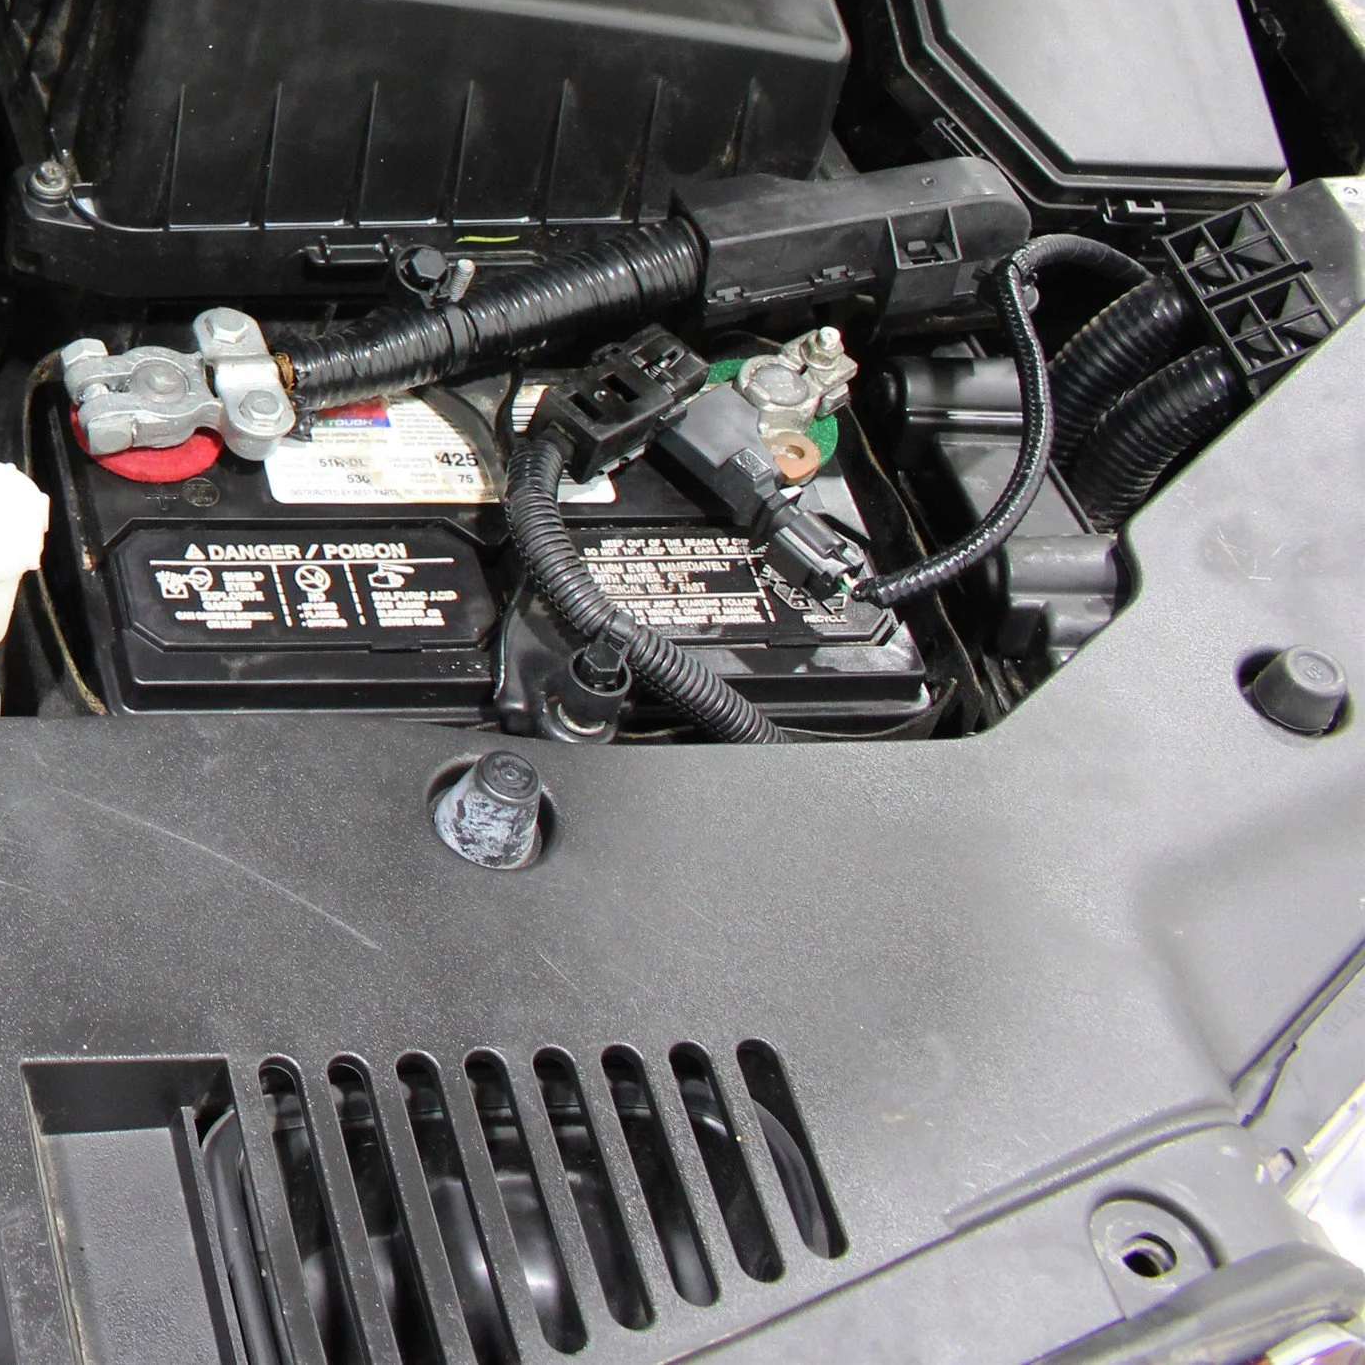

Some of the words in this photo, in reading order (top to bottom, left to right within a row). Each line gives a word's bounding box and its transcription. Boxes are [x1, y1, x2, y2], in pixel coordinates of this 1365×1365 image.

[440, 453, 479, 467] 425
[458, 474, 474, 484] 75
[600, 539, 624, 548] KEEP
[626, 539, 646, 547] OUT
[647, 539, 661, 547] OF
[663, 538, 683, 547] THE
[684, 538, 715, 547] REACH
[716, 538, 729, 546] OF
[207, 544, 302, 560] DANGER
[323, 542, 408, 559] POISON
[583, 547, 598, 556] DO
[600, 547, 619, 556] NOT
[642, 547, 666, 555] KEEP
[668, 546, 692, 555] VENT
[694, 546, 719, 554] CAPS
[587, 562, 624, 574] FLUSH
[625, 562, 657, 573] EYES
[657, 561, 731, 573] IMMEDIATELY
[221, 571, 265, 582] SHIELD
[591, 573, 621, 584] WITH
[667, 572, 690, 582] GET
[678, 582, 706, 593] FAST
[199, 590, 265, 602] EXPLOSIVE
[370, 591, 429, 601] SULFURIC
[429, 591, 458, 601] ACID
[627, 600, 651, 609] SAFE
[678, 598, 721, 608] STARTING
[722, 598, 758, 607] FOLLOW
[645, 608, 682, 617] VEHICLE
[682, 607, 721, 616] OWNERS
[647, 616, 672, 625] SEEK
[672, 615, 709, 624] SERVICE
[802, 614, 848, 624] RECYCLE
